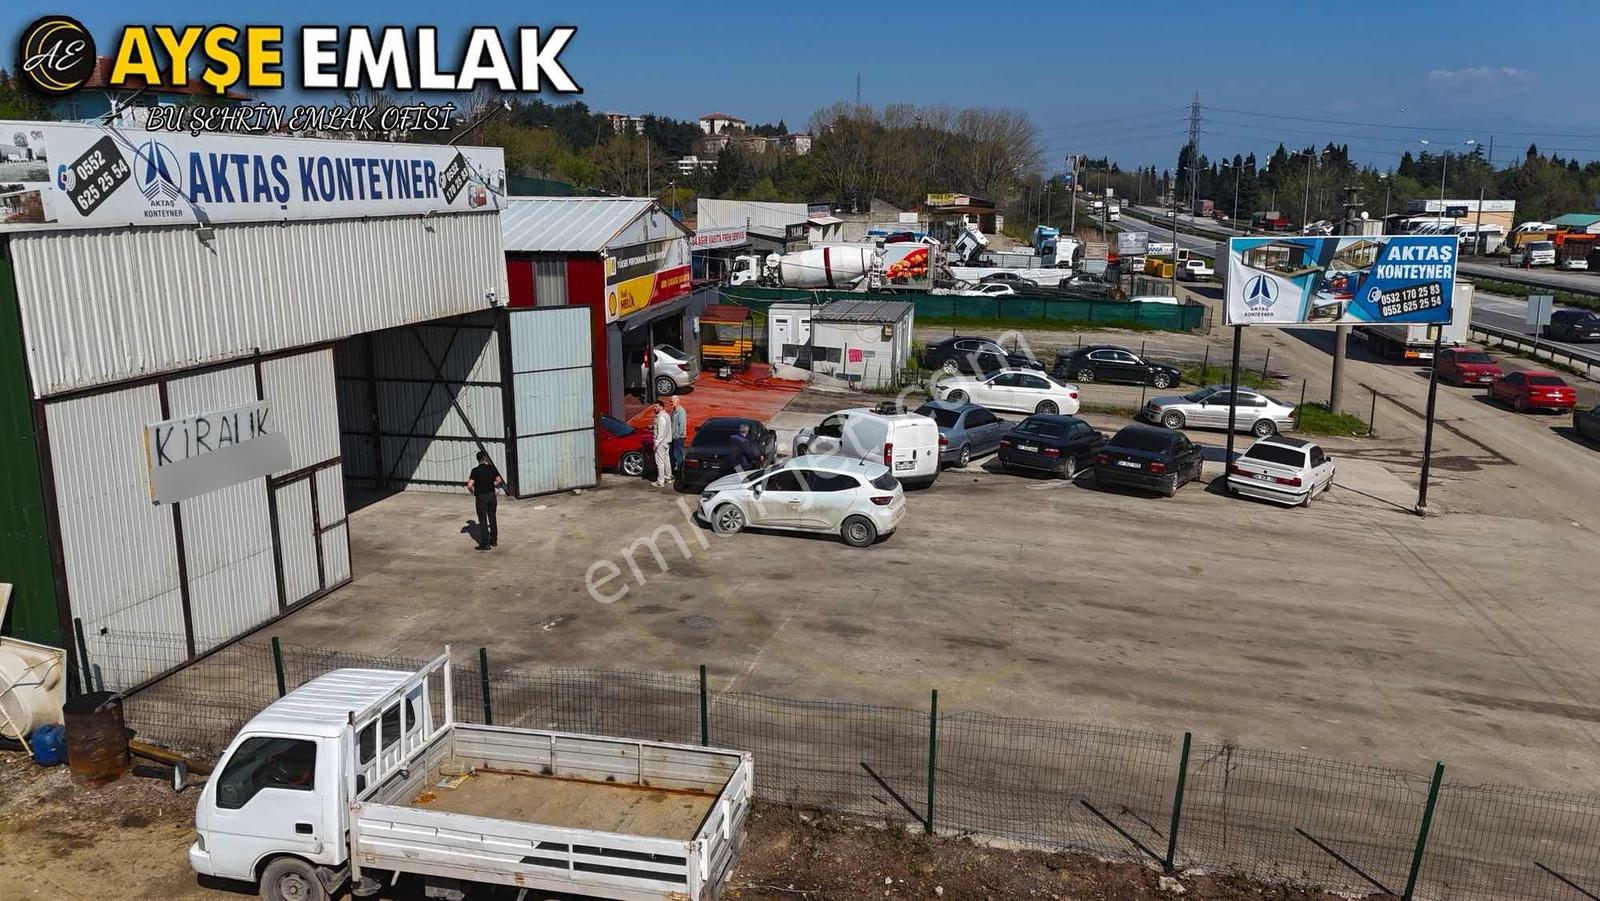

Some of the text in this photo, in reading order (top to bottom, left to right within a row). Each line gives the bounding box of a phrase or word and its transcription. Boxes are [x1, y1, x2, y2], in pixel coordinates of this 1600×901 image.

[76, 150, 106, 181] 0552
[77, 158, 129, 210] 625 25 54
[189, 152, 438, 210] AKTAŞ KONTEYNER
[150, 200, 175, 208] AKTAŞ
[1387, 245, 1453, 263] AKTAŞ
[1376, 264, 1452, 279] KONTEYNER
[1381, 284, 1440, 305] 0532 170 25 83
[1382, 295, 1442, 317] 0552 625 25 54
